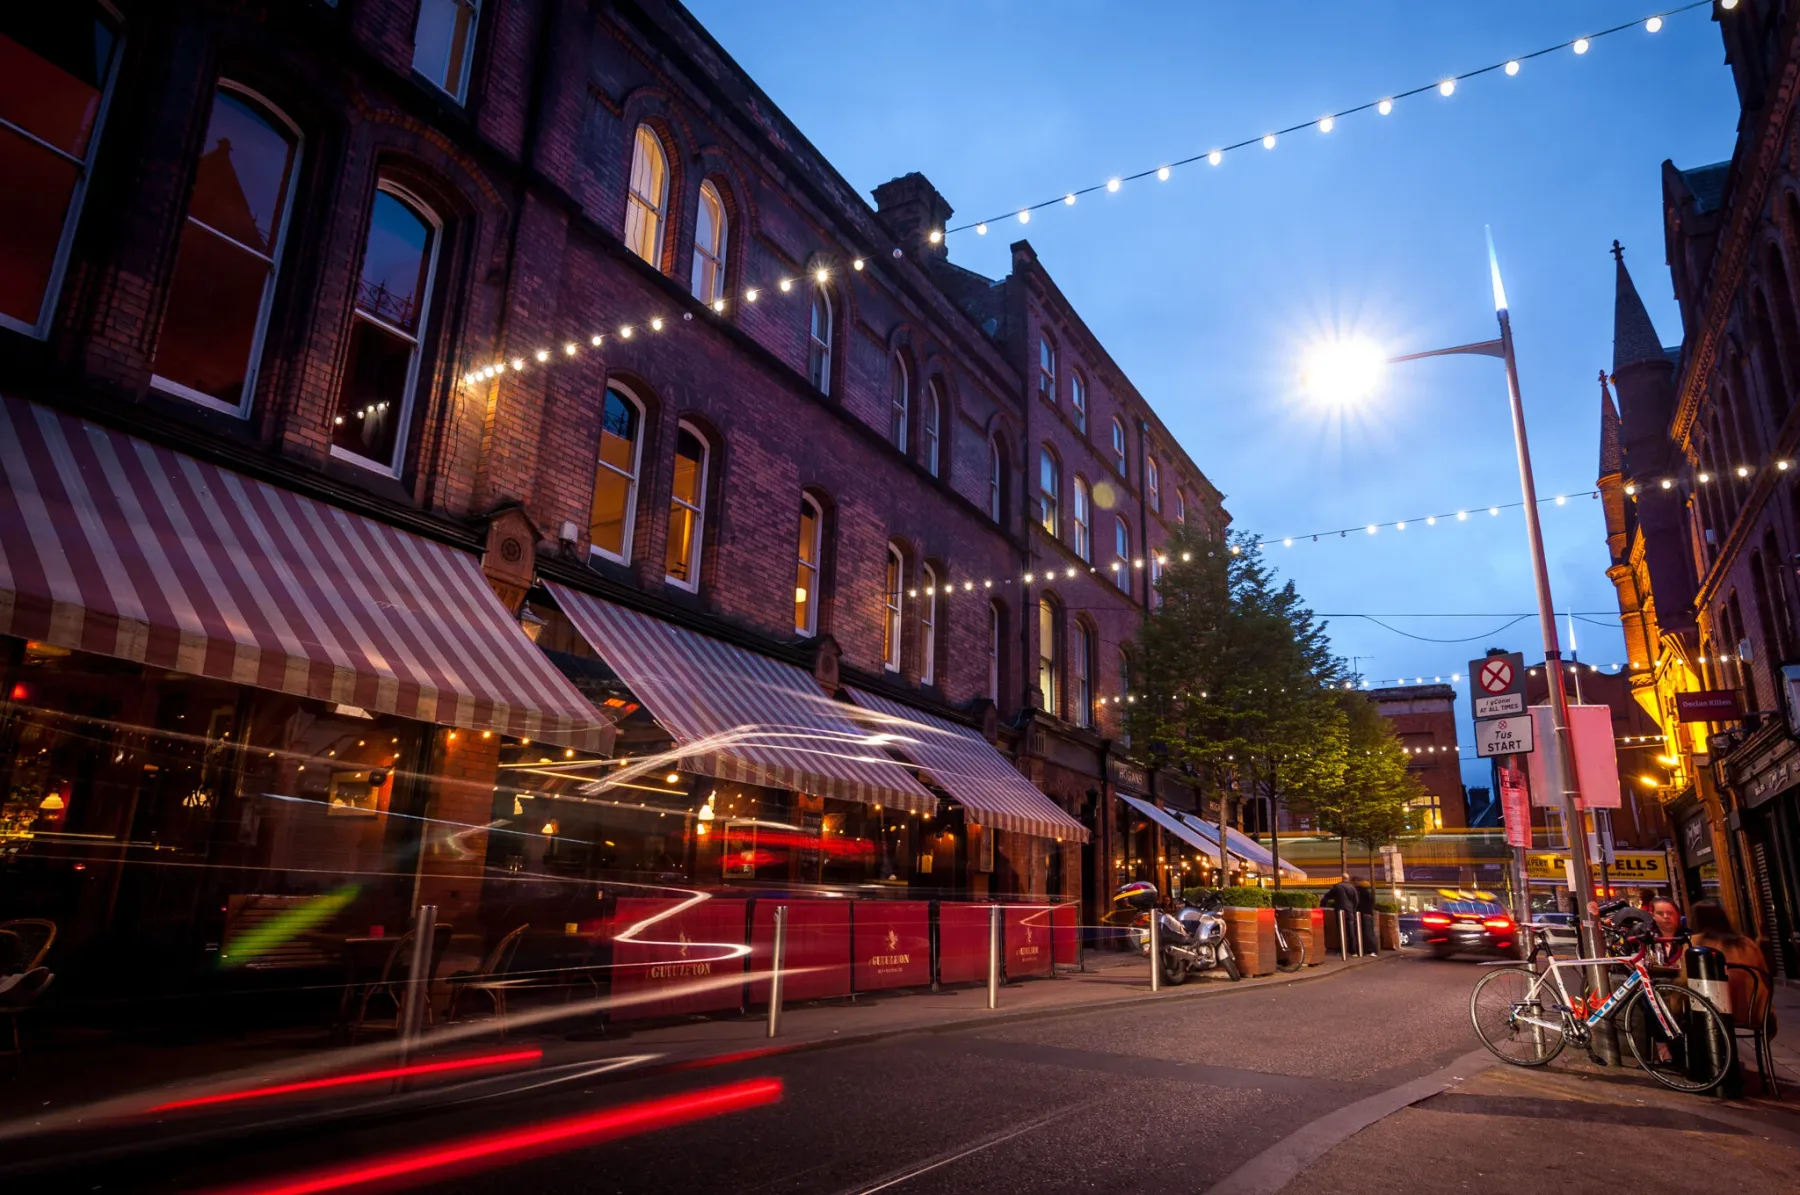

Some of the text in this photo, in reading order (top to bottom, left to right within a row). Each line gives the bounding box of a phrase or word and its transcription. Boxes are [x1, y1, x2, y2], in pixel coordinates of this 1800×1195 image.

[1501, 703, 1519, 711] TIMES
[1487, 739, 1522, 752] START
[1119, 767, 1143, 785] HOGANS
